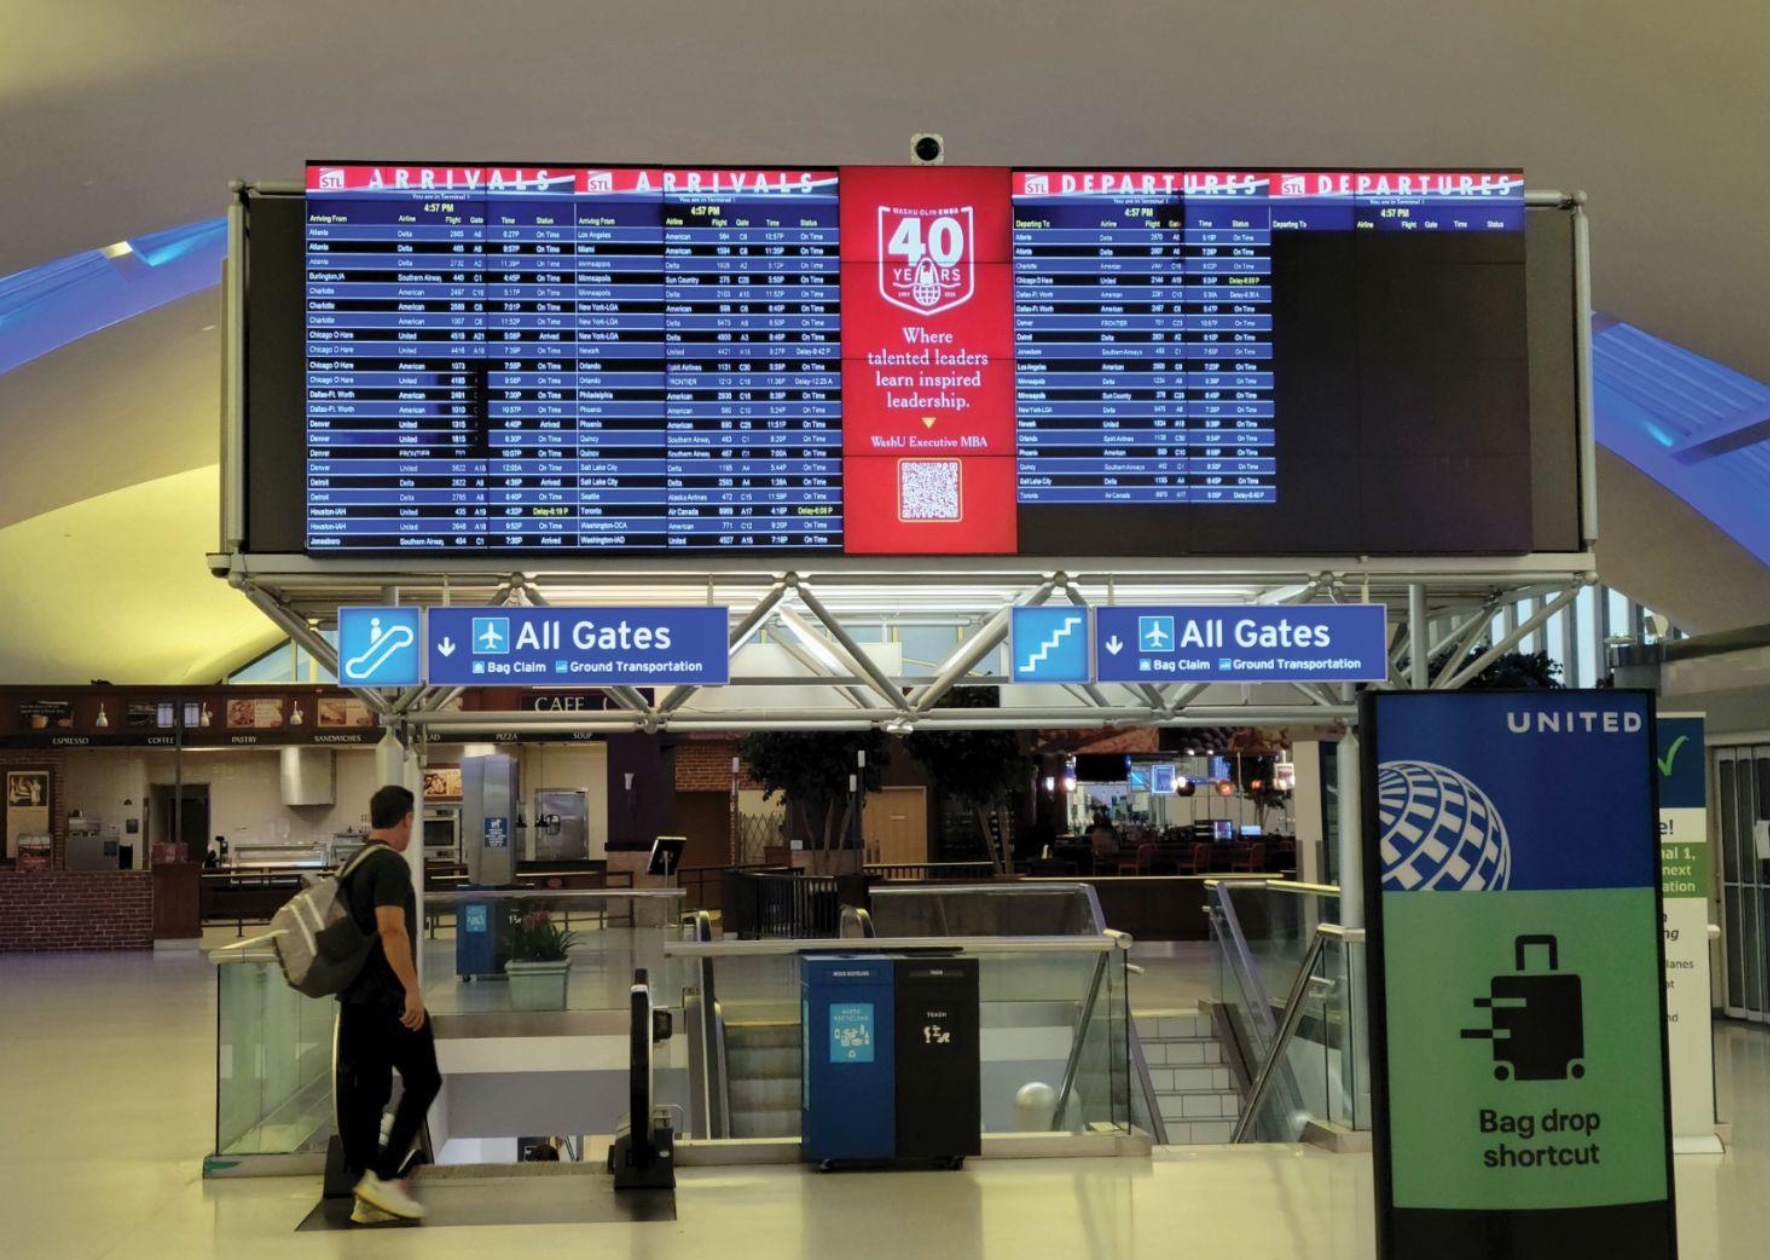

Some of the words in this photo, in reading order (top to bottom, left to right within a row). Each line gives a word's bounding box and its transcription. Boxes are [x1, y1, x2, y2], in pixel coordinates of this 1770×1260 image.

[322, 176, 342, 188] STL
[369, 168, 549, 190] ARRIVALS
[590, 180, 610, 190] STL
[636, 172, 812, 193] ARRIVALS
[1062, 174, 1256, 194] DEPARTURES
[1027, 183, 1047, 193] STL
[1284, 184, 1304, 194] STL
[1318, 176, 1510, 196] DEPARTURES
[424, 203, 440, 212] 4:57
[442, 203, 454, 212] PM
[690, 206, 706, 215] 4:57
[708, 206, 720, 215] PM
[1124, 208, 1140, 216] 4:57
[1142, 208, 1154, 216] PM
[1380, 208, 1396, 218] 4:57
[1398, 208, 1409, 218] PM
[310, 215, 332, 223] Arriving
[446, 216, 462, 224] Flight
[579, 218, 600, 226] Arriving
[712, 219, 727, 227] Flight
[1016, 220, 1041, 229] Departing
[1146, 220, 1160, 229] Flight
[1272, 221, 1298, 230] Departing
[1402, 222, 1416, 230] Flight
[888, 217, 964, 268] 40
[398, 304, 425, 312] American
[310, 332, 333, 340] Chicago
[902, 327, 953, 344] Where
[868, 348, 930, 365] talented
[935, 348, 989, 365] leaders
[876, 370, 914, 387] learn
[919, 370, 982, 390] inspired
[398, 392, 426, 400] American
[887, 391, 970, 411] leadership.
[310, 420, 330, 428] Denver
[871, 436, 906, 448] WashU
[909, 436, 958, 448] Executive
[961, 436, 988, 448] MBA
[515, 620, 560, 650] All
[572, 620, 672, 650] Gates
[1180, 619, 1223, 648] All
[1234, 619, 1331, 648] Gates
[487, 662, 510, 674] Bag
[514, 661, 546, 673] Claim
[570, 661, 613, 673] Ground
[616, 660, 703, 674] Transportation
[1154, 660, 1176, 672] Bag
[1178, 658, 1210, 670] Claim
[1233, 658, 1275, 670] Ground
[1277, 656, 1361, 670] Transportation
[1507, 712, 1642, 734] UNITED
[1662, 865, 1692, 876] next
[1480, 1109, 1535, 1139] Bag
[1541, 1107, 1600, 1136] drop
[1484, 1143, 1600, 1168] shortcut
